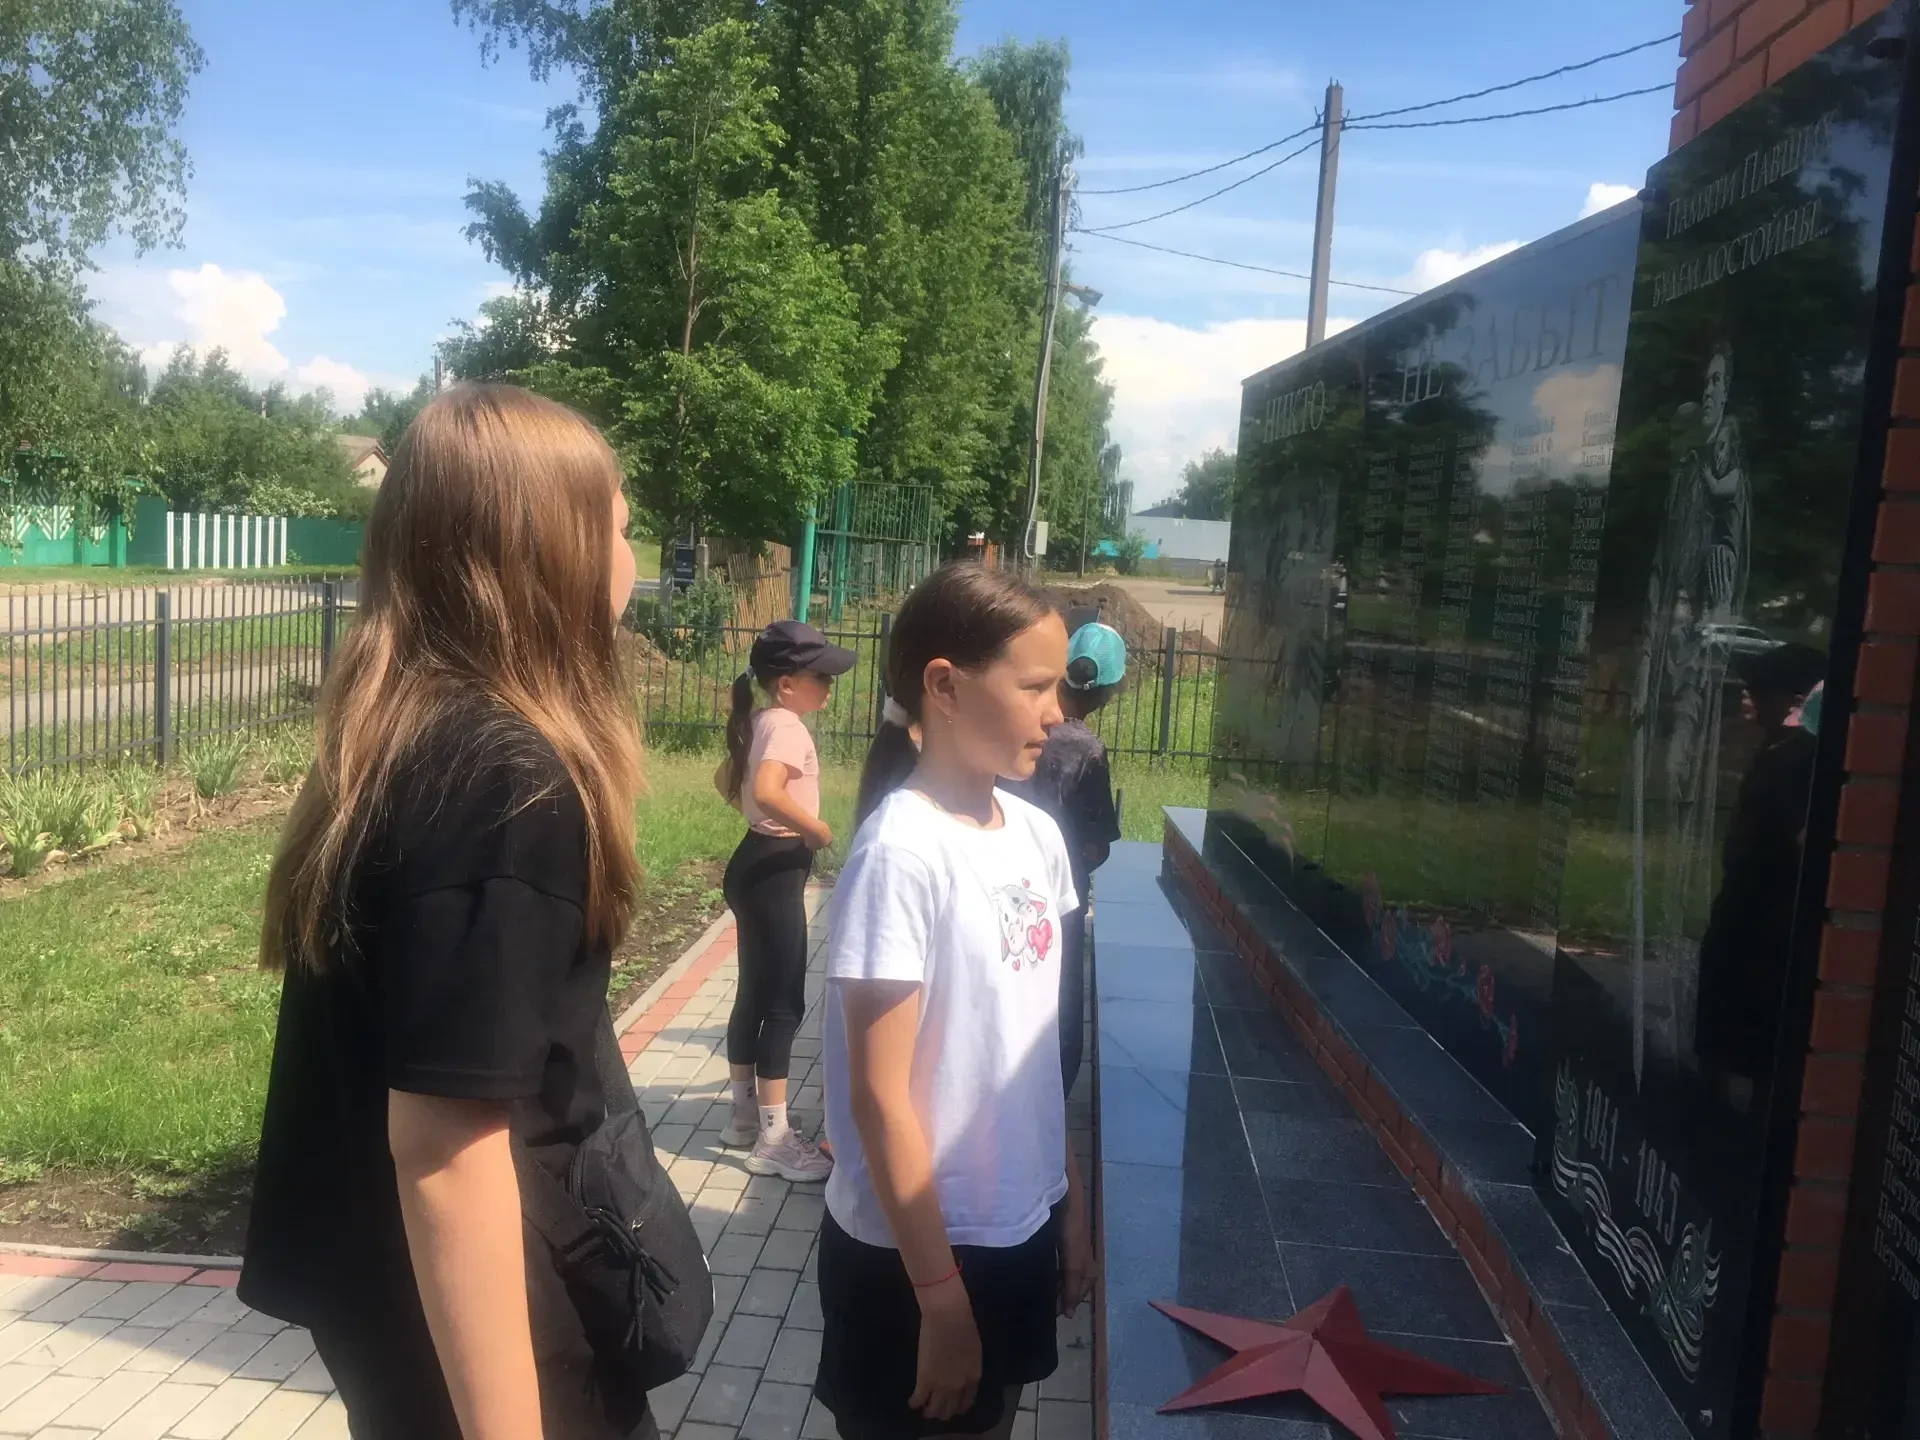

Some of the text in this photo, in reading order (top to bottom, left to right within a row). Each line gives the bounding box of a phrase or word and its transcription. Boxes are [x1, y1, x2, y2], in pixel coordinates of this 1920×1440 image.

[1263, 274, 1620, 444] НИКТО НЕ ЗАБЫТ
[1583, 1080, 1619, 1171] 1941
[1634, 1139, 1680, 1245] 1945
